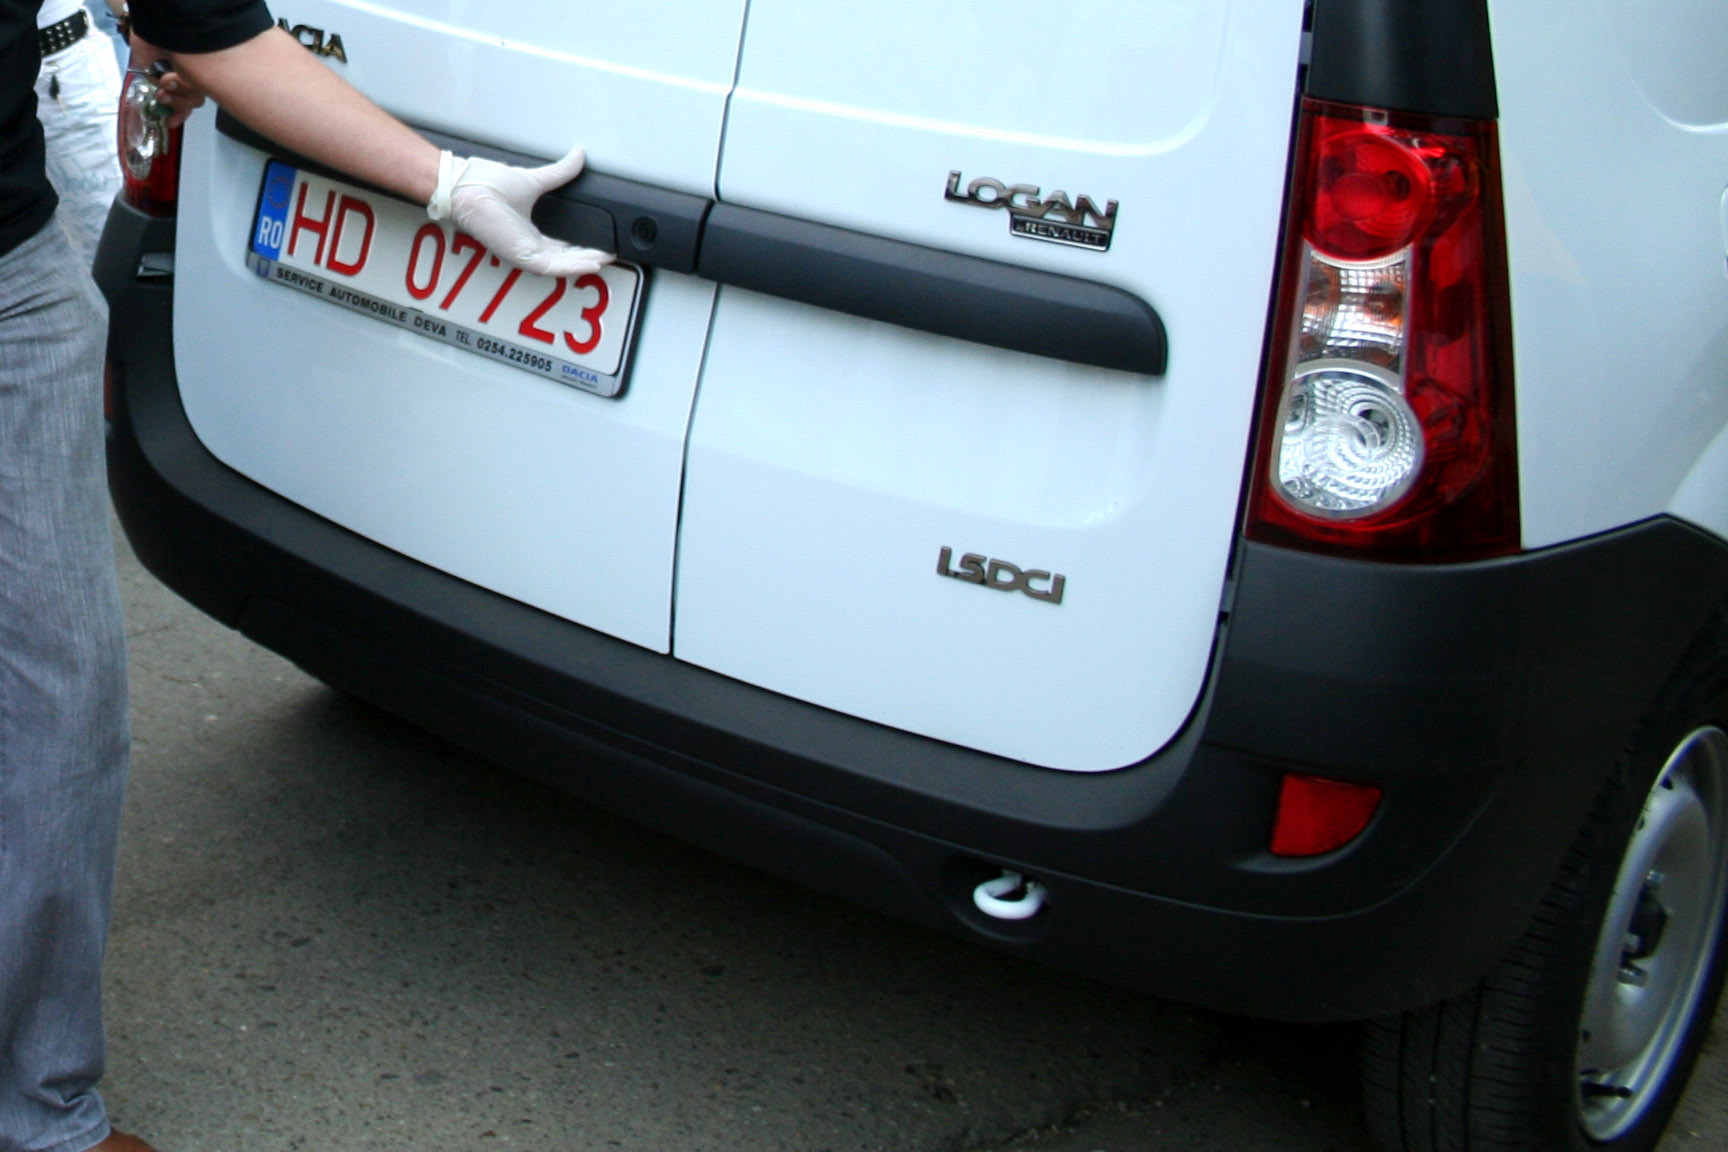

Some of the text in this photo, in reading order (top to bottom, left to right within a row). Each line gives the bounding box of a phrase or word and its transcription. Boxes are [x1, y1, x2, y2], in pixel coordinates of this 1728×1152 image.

[287, 182, 375, 276] HD
[944, 169, 1120, 230] LOGAN
[259, 216, 283, 249] RO
[1025, 222, 1105, 245] RENAULT
[277, 268, 323, 293] SERVICE
[329, 286, 406, 322] AUTOMOBILE
[414, 316, 447, 337] DEVA
[477, 338, 552, 372] 0254.225905
[562, 364, 598, 383] DACIA
